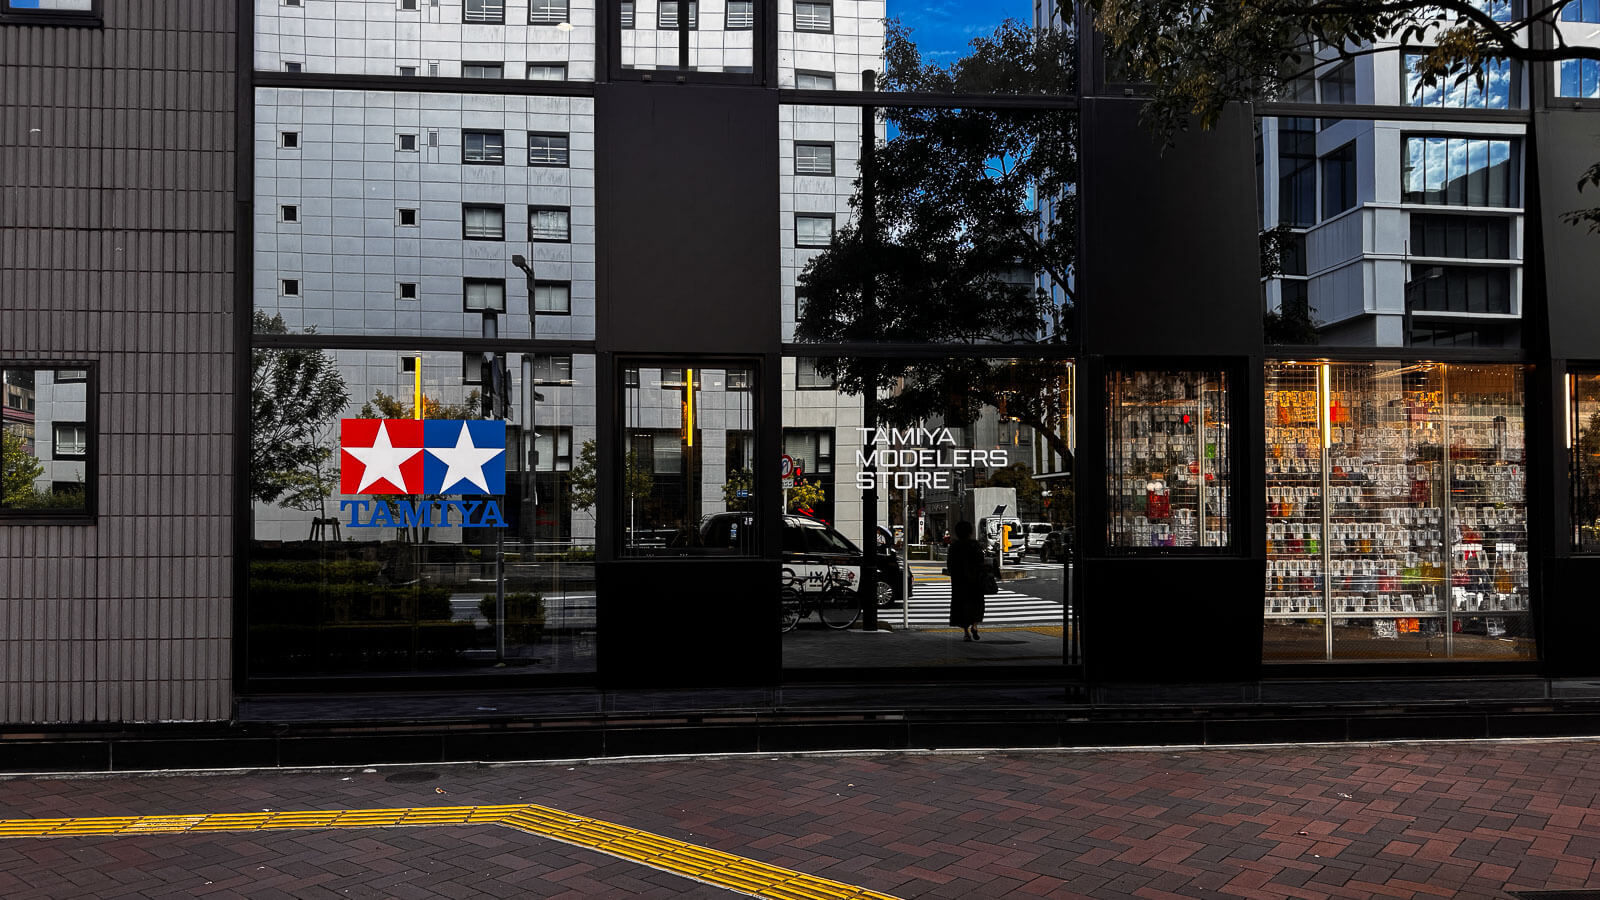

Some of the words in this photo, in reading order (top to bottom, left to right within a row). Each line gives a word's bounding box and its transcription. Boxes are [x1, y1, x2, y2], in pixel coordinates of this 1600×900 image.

[855, 427, 957, 445] TAMIYA
[855, 449, 1008, 467] MODELERS
[855, 471, 950, 489] STORE
[340, 500, 509, 527] TAMIYA
